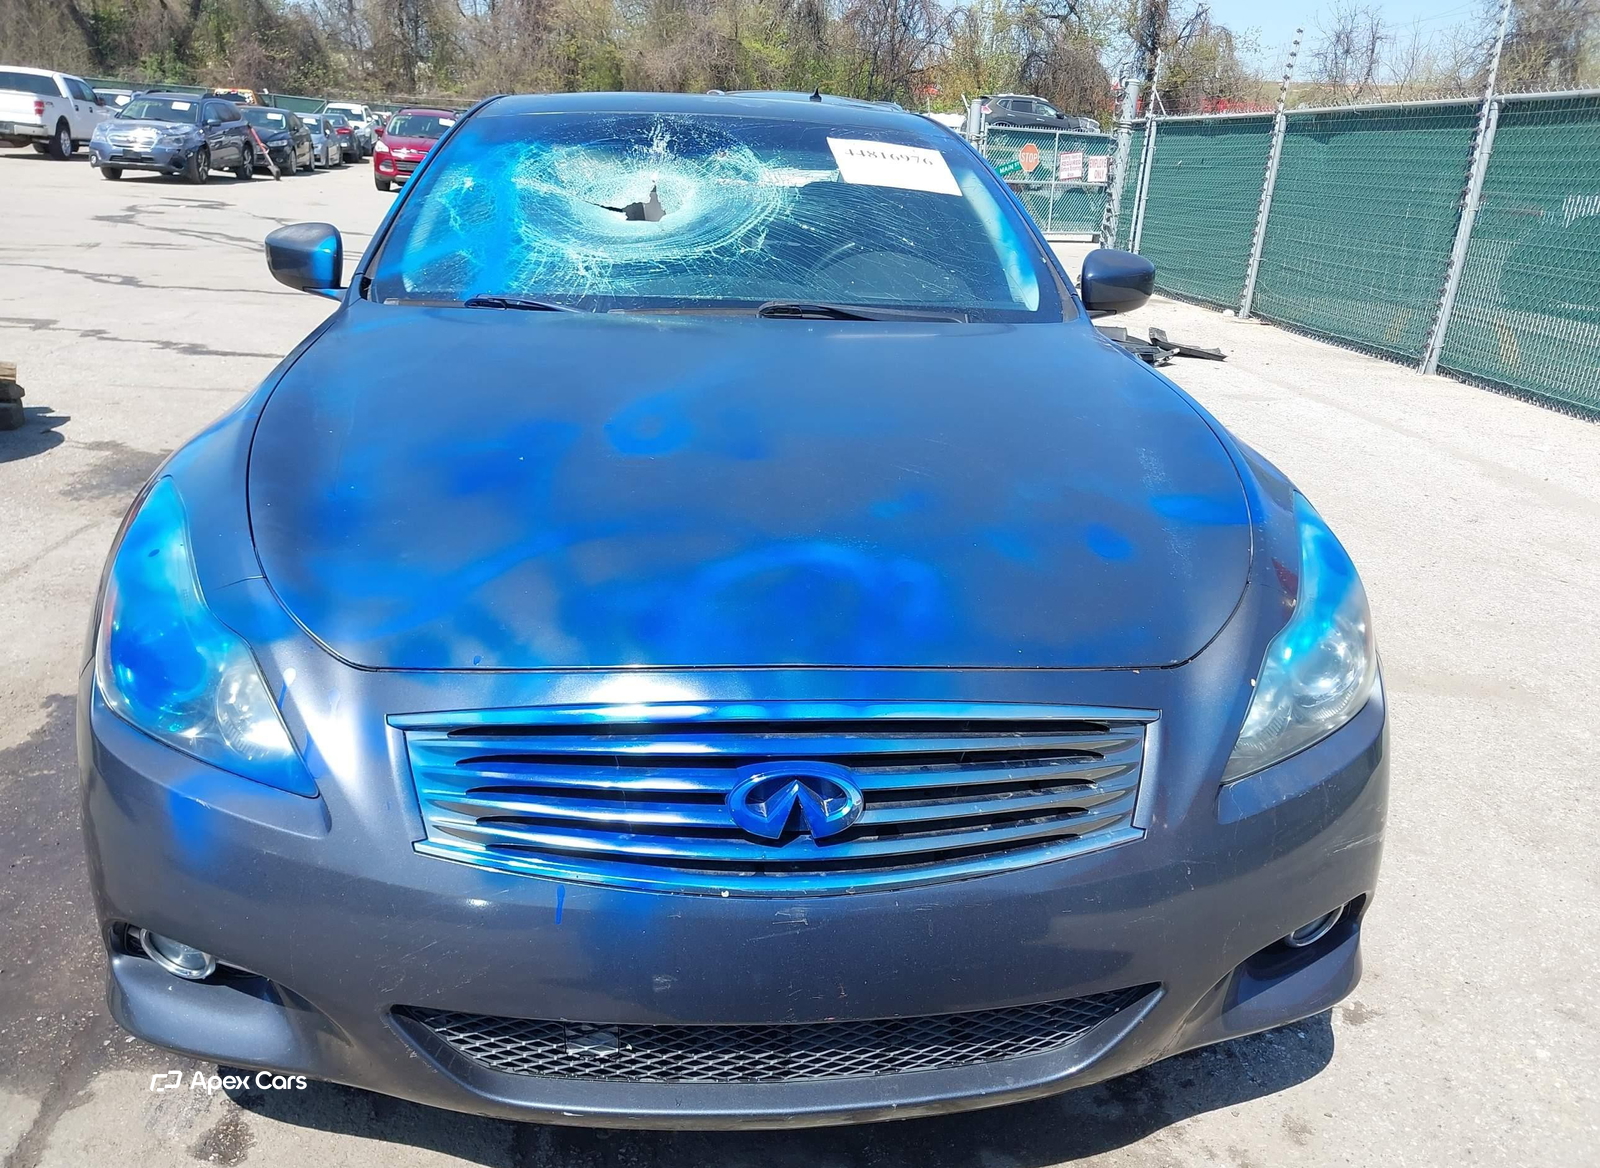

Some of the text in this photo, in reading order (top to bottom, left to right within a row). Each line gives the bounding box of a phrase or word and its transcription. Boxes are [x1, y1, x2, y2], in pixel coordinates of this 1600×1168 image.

[1021, 152, 1038, 163] STOP
[999, 163, 1014, 173] MAIN
[1094, 169, 1105, 180] ONLY
